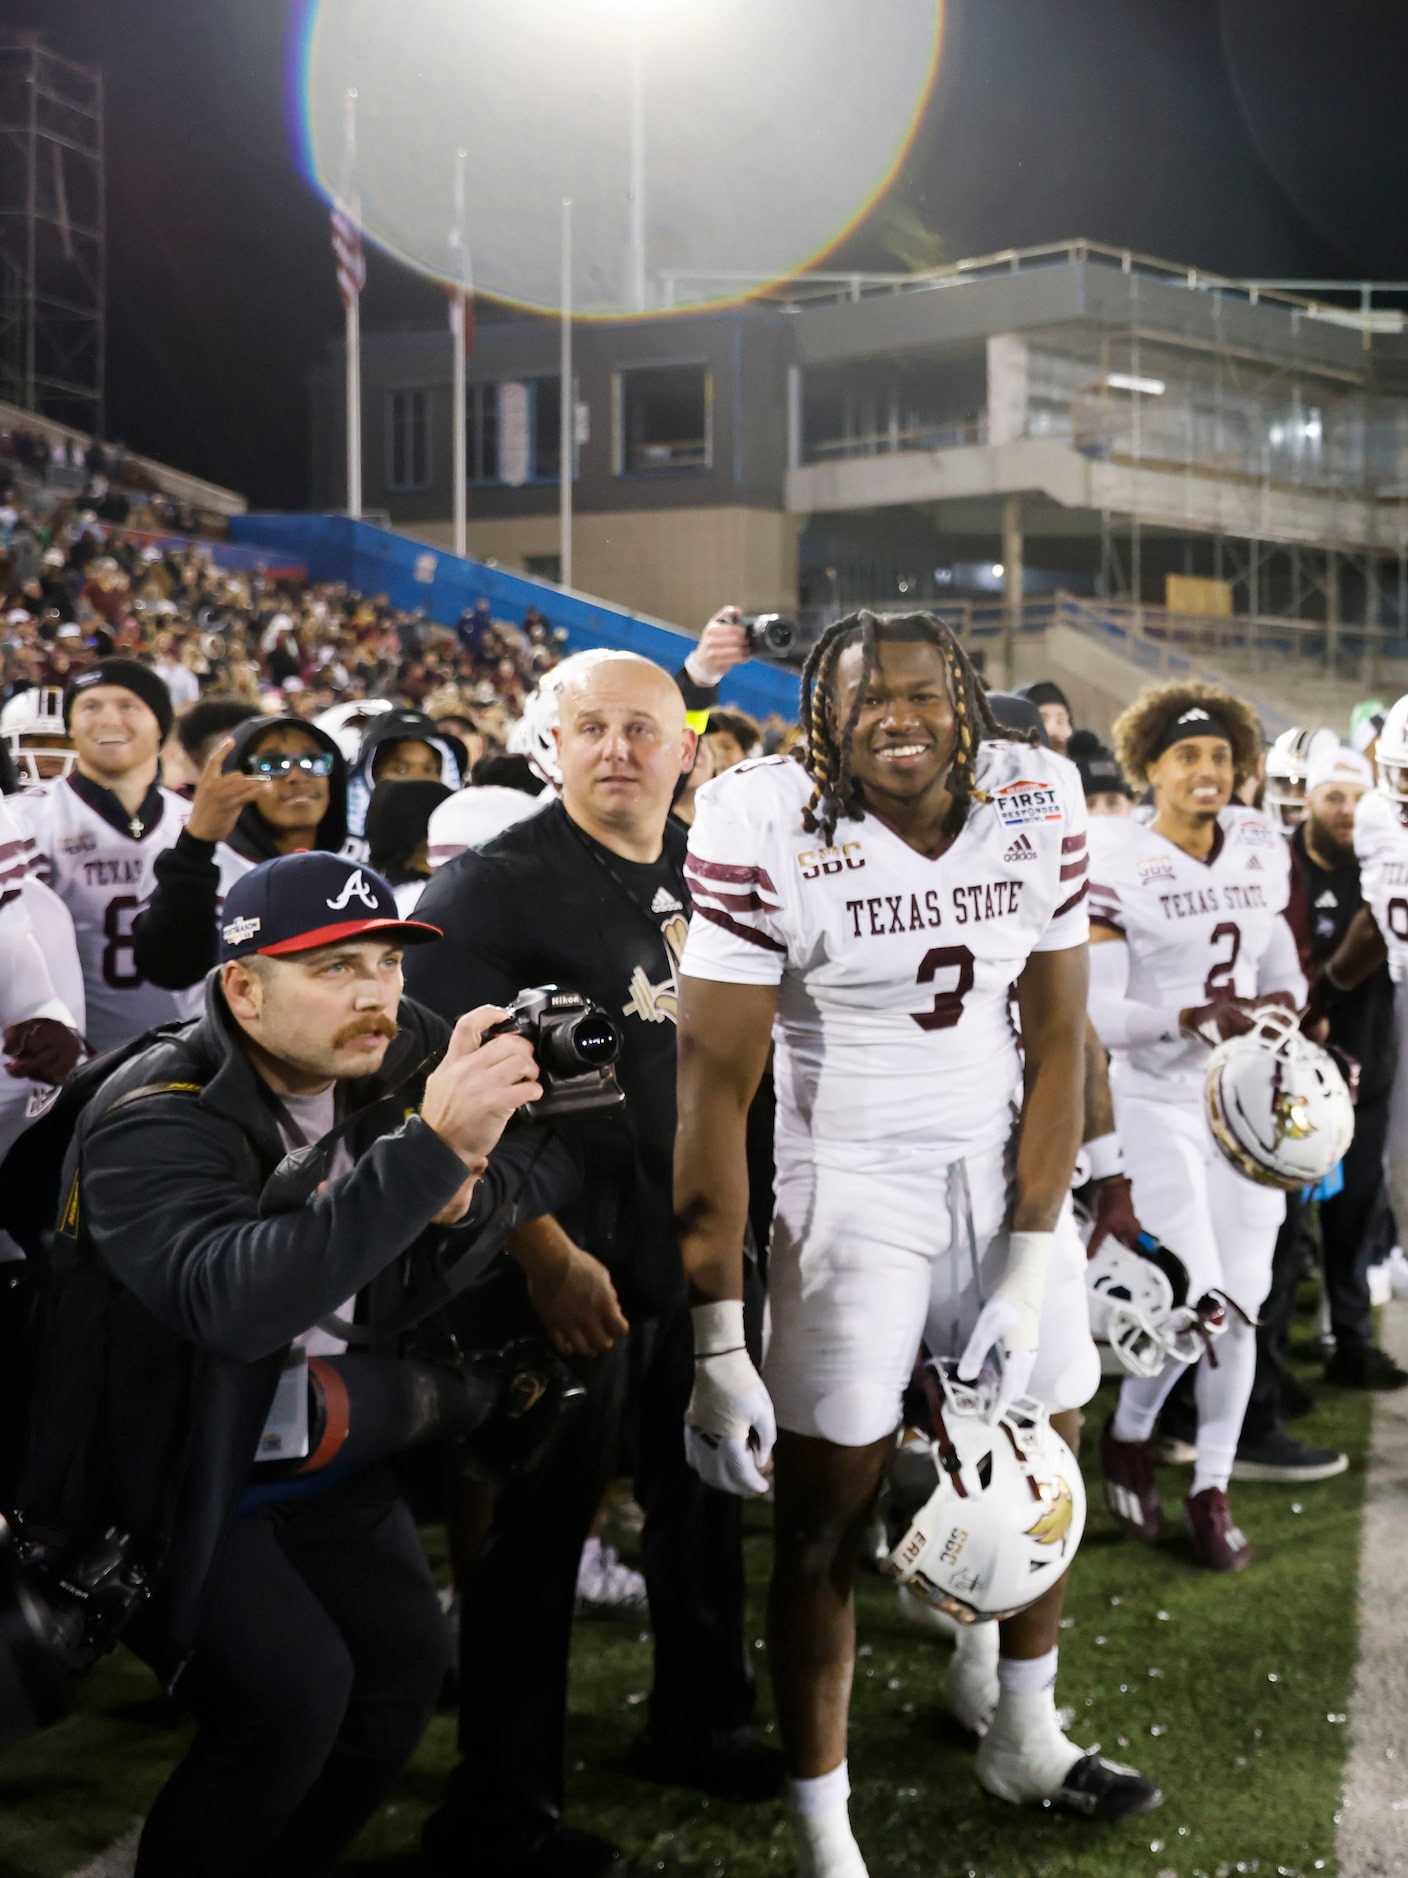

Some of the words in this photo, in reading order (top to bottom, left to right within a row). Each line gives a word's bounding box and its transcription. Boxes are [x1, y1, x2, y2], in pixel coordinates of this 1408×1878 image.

[1001, 806, 1061, 819] RESPONDER
[797, 841, 867, 881] SBC
[1003, 851, 1038, 862] adidas
[326, 869, 379, 910] A
[846, 890, 942, 938] TEXAS
[952, 880, 1024, 925] STATE
[1159, 887, 1219, 920] TEXAS
[1223, 884, 1267, 911] STATE
[1203, 921, 1241, 999] 2
[551, 996, 579, 1006] Nikon
[909, 944, 976, 1032] 3
